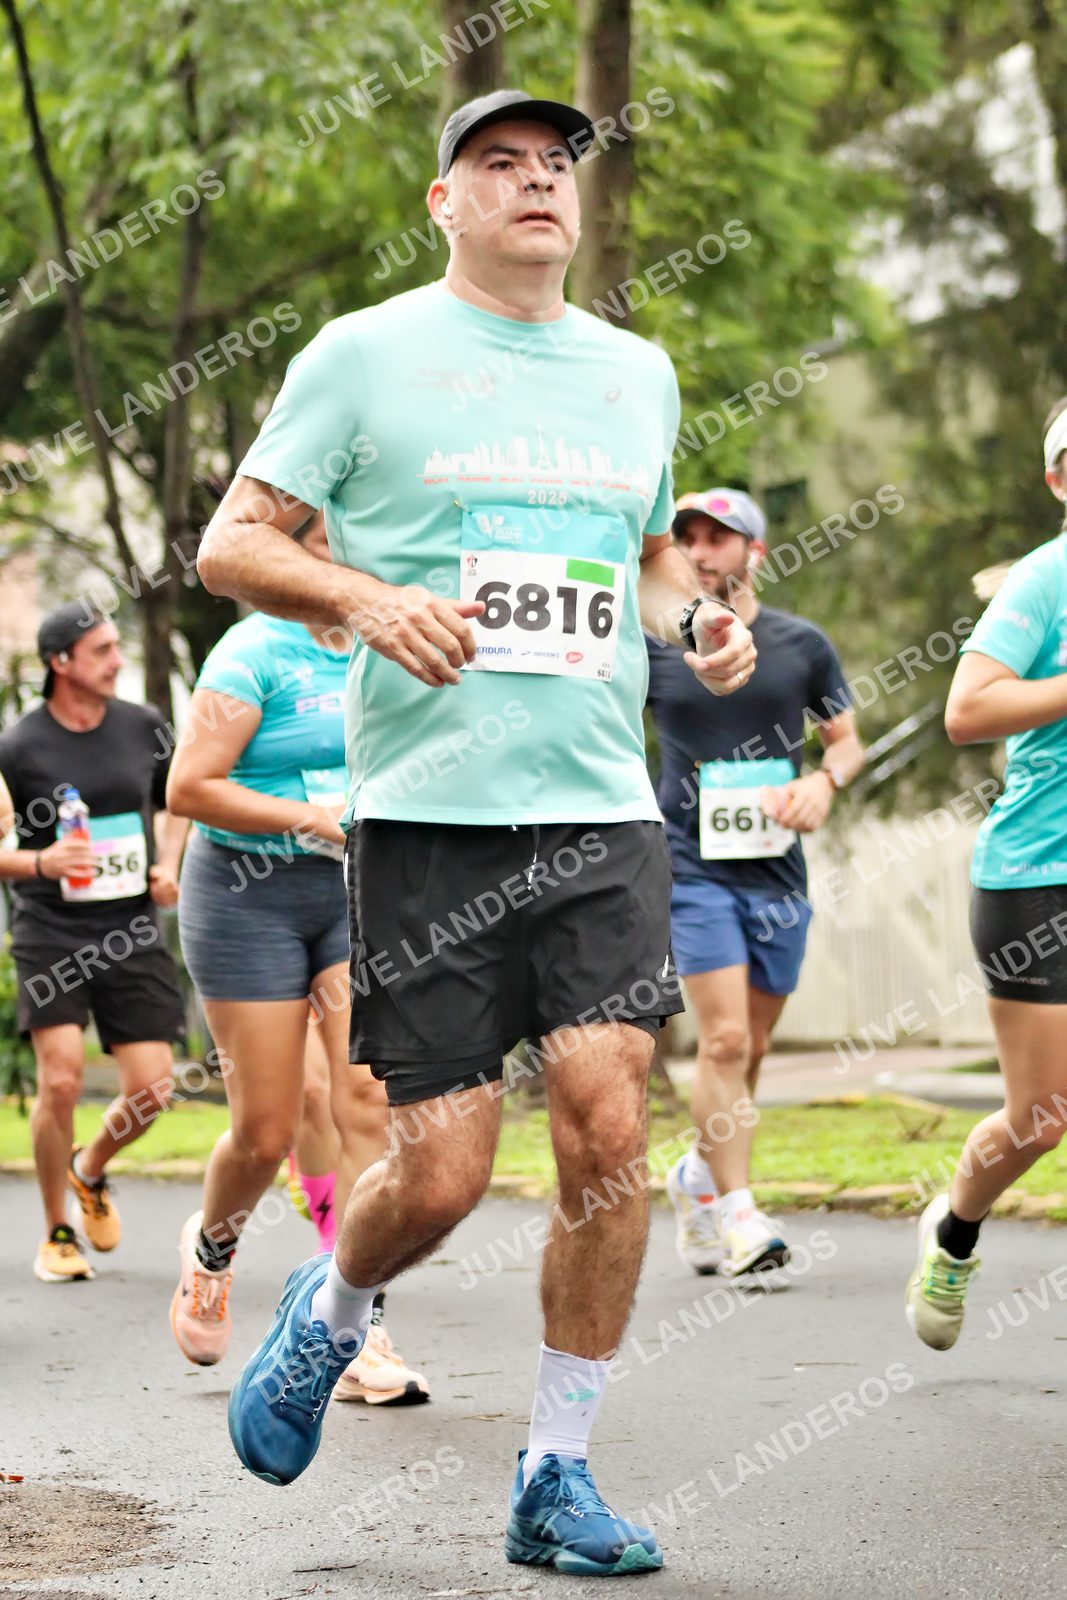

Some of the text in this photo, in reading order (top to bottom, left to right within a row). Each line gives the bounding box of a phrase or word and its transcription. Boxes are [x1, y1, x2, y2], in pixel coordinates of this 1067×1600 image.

[527, 489, 568, 505] 2025
[475, 581, 615, 639] 6816
[476, 646, 512, 656] ERDURA
[711, 807, 769, 832] 661
